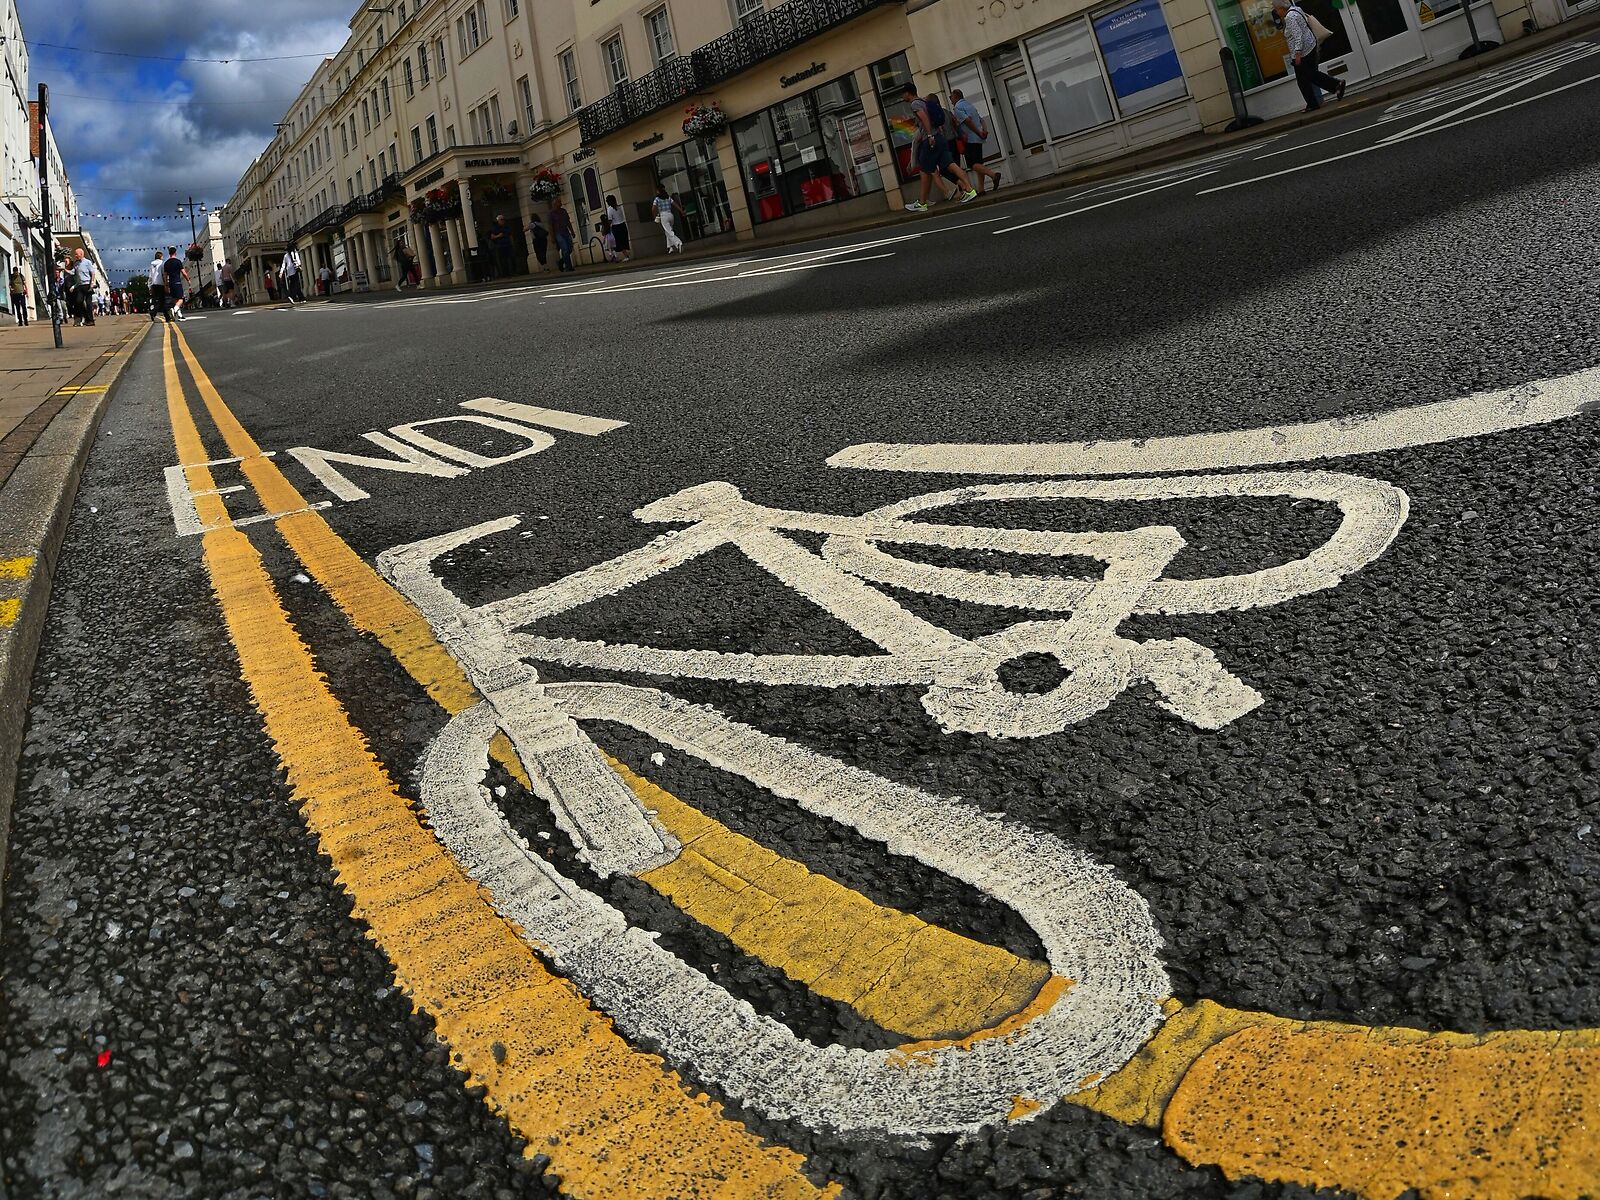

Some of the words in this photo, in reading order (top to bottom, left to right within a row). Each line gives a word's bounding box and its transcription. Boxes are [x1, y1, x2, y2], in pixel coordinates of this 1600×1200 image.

[779, 61, 827, 89] Santander
[632, 131, 664, 152] Santander
[465, 159, 491, 168] ROYAL
[491, 156, 520, 167] PRIORS
[572, 147, 596, 164] NatWes
[164, 415, 557, 537] END
